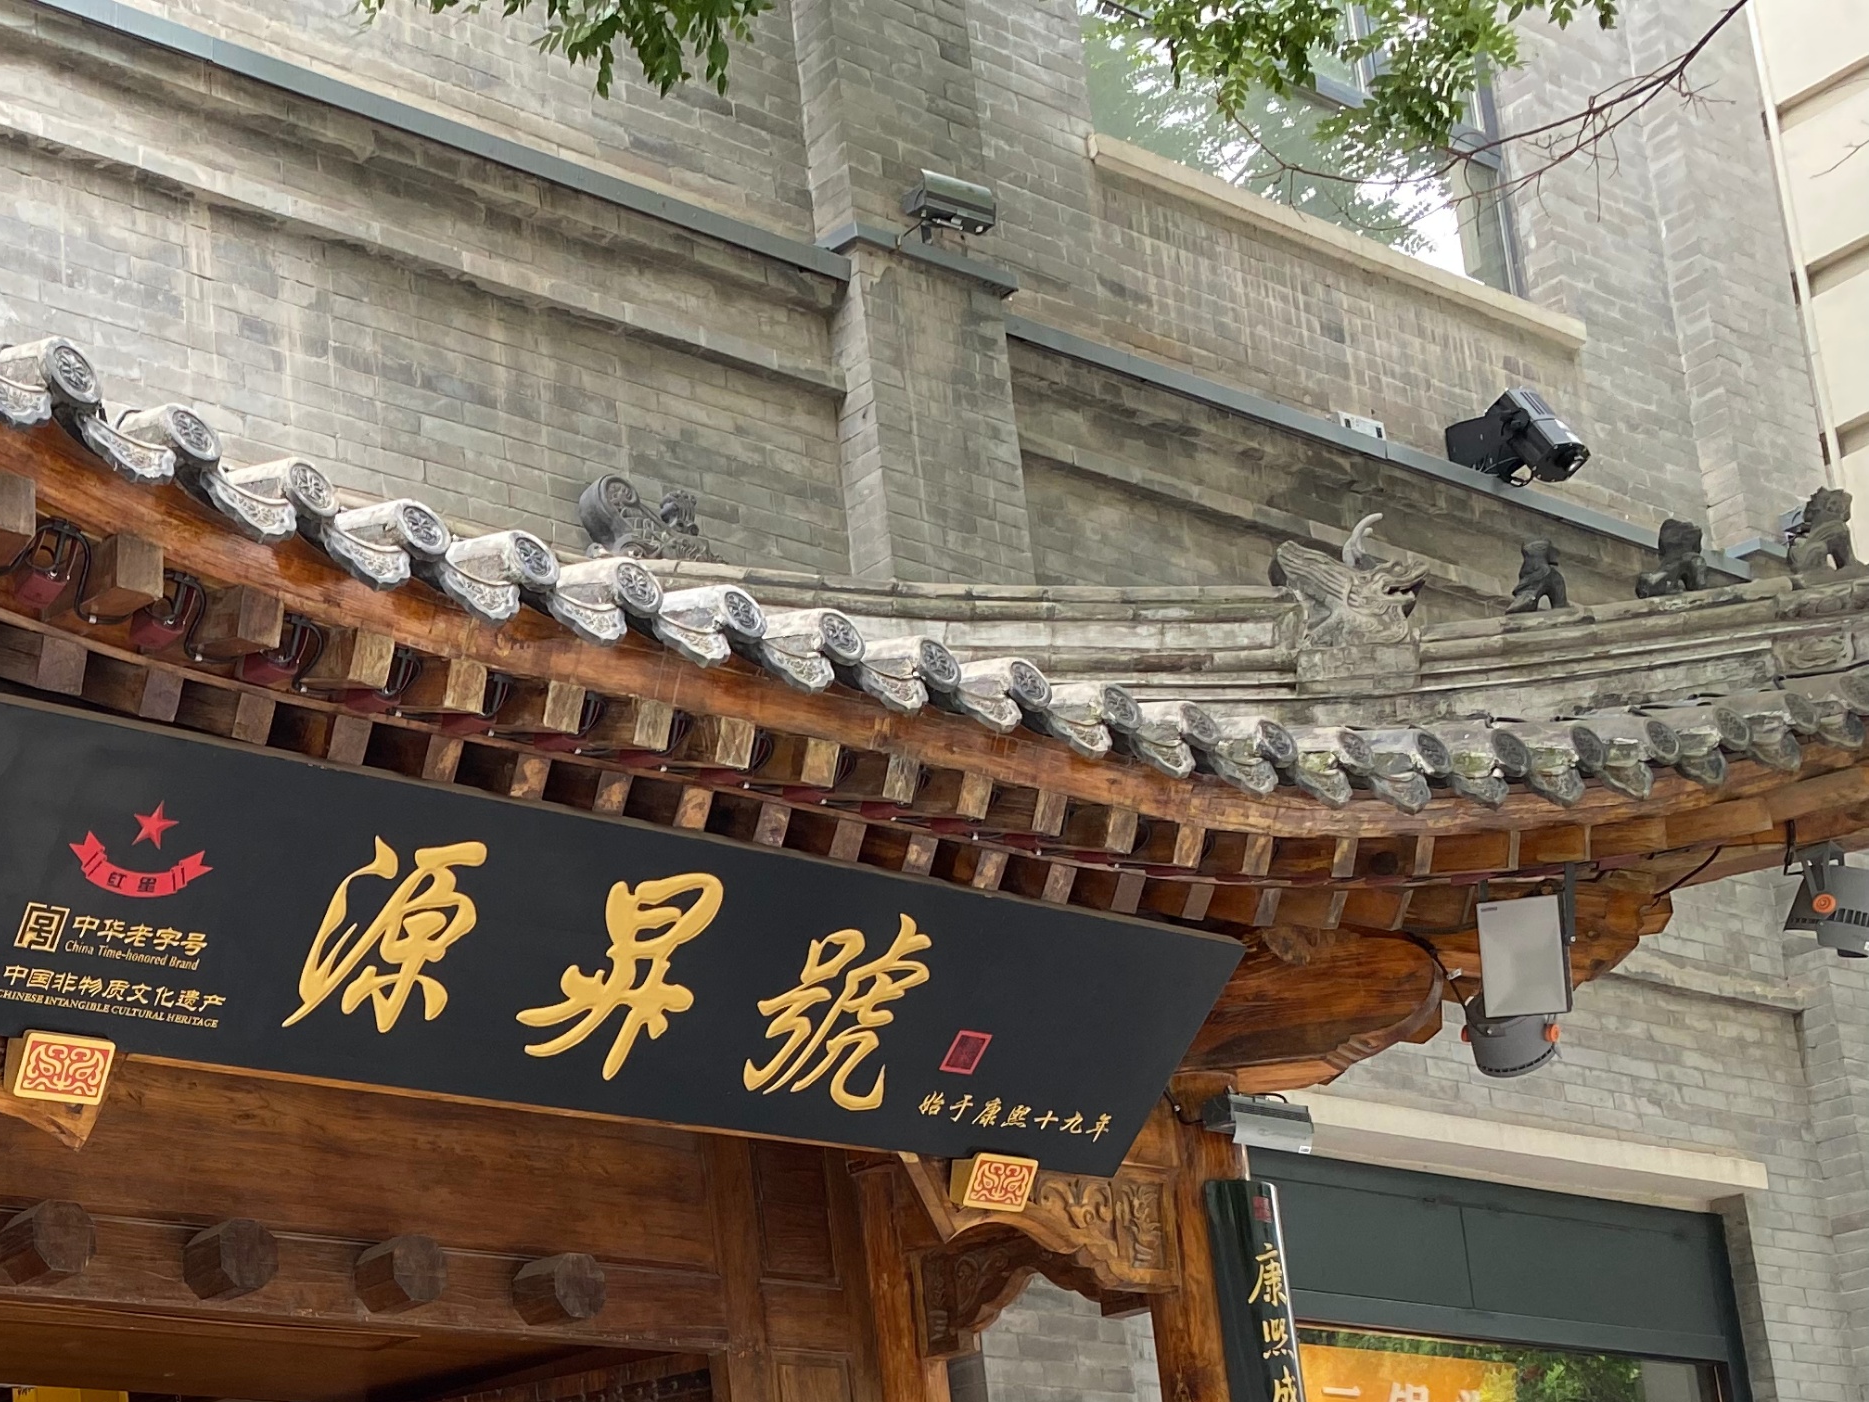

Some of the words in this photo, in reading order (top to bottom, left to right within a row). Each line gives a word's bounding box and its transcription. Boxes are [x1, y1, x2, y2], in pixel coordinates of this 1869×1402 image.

[72, 915, 208, 957] 中华老字号
[64, 940, 95, 957] China
[97, 945, 168, 967] Time-honored
[168, 956, 201, 971] Brand
[3, 965, 226, 1013] 中国非物质文化遗产
[44, 995, 110, 1014] INTANGIBLE
[110, 1005, 165, 1021] CULTURAL
[166, 1013, 219, 1029] HERITAGE
